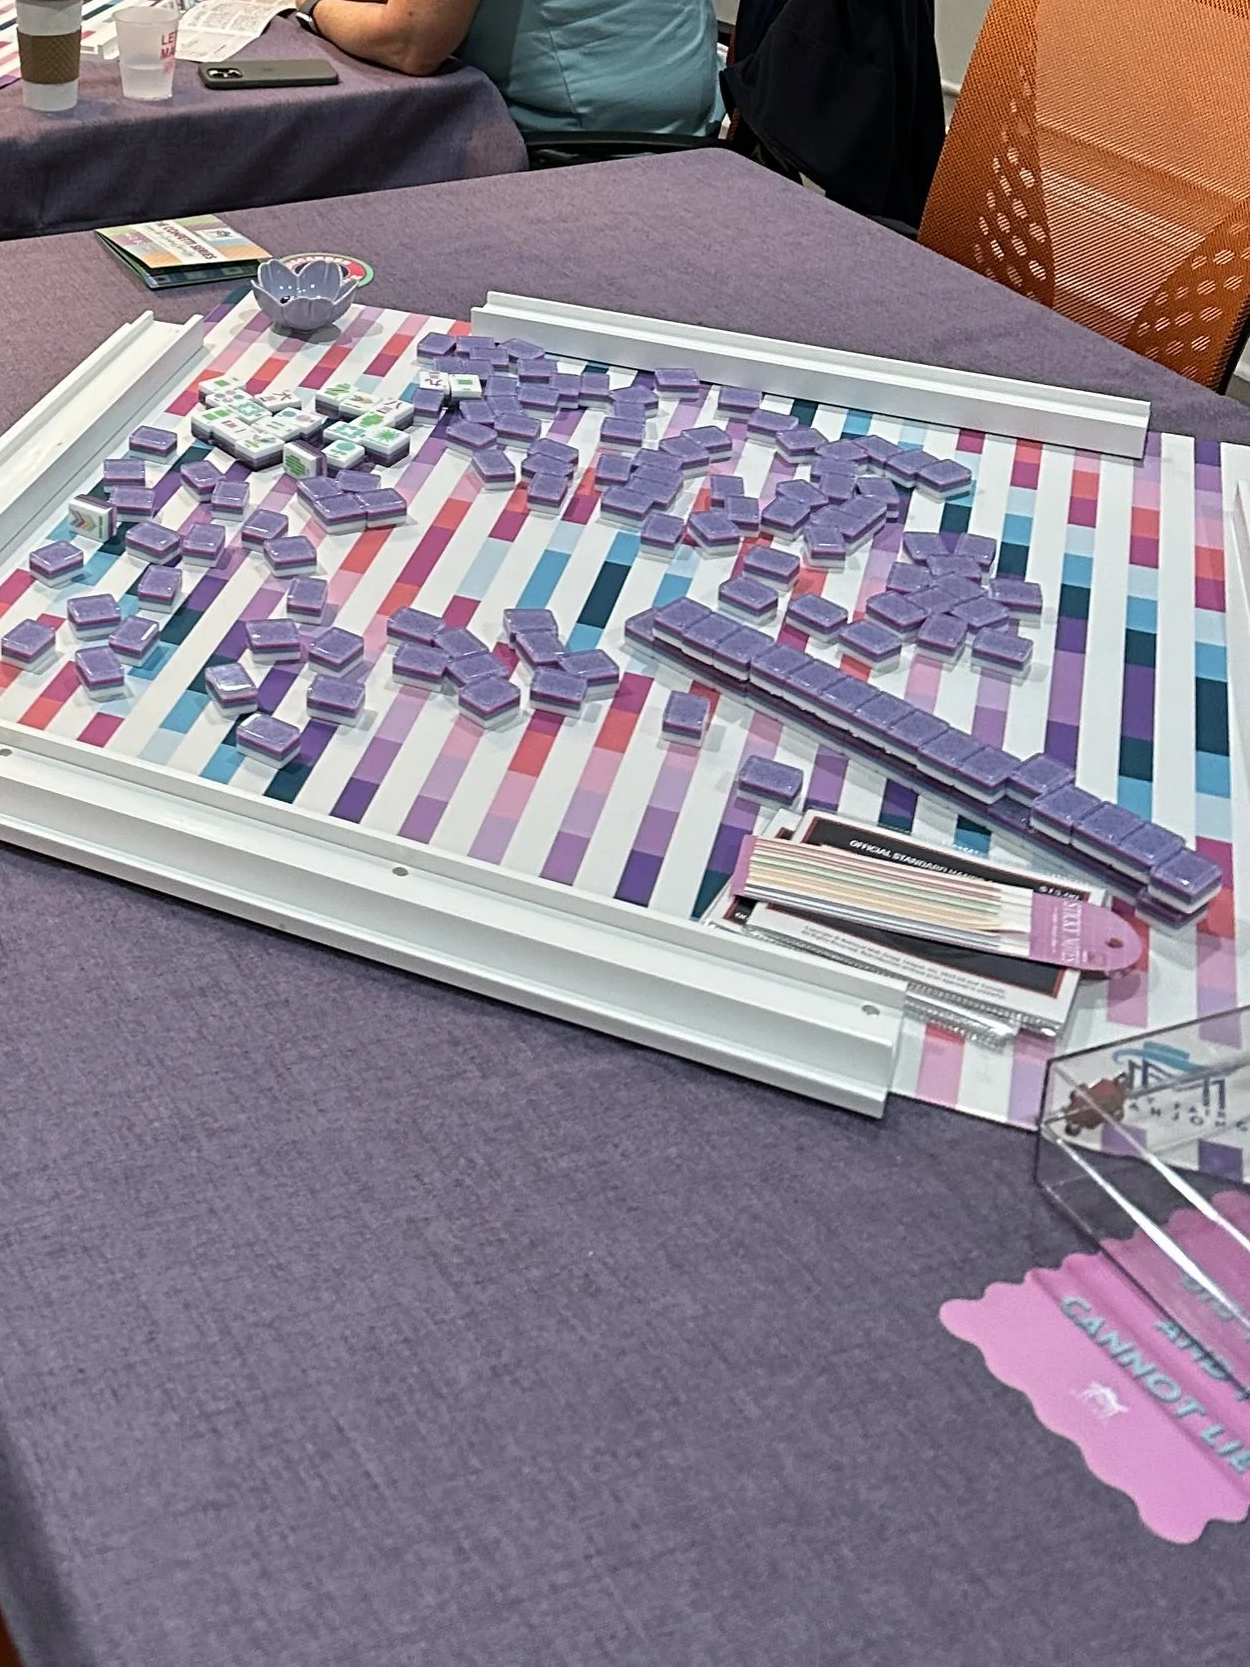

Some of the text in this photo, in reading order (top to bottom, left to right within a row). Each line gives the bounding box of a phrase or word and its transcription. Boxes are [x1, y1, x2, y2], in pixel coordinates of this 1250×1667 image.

[849, 839, 893, 860] OFFICIAL
[1128, 1100, 1250, 1132] AHJONG
[1059, 1295, 1207, 1419] CANNOT
